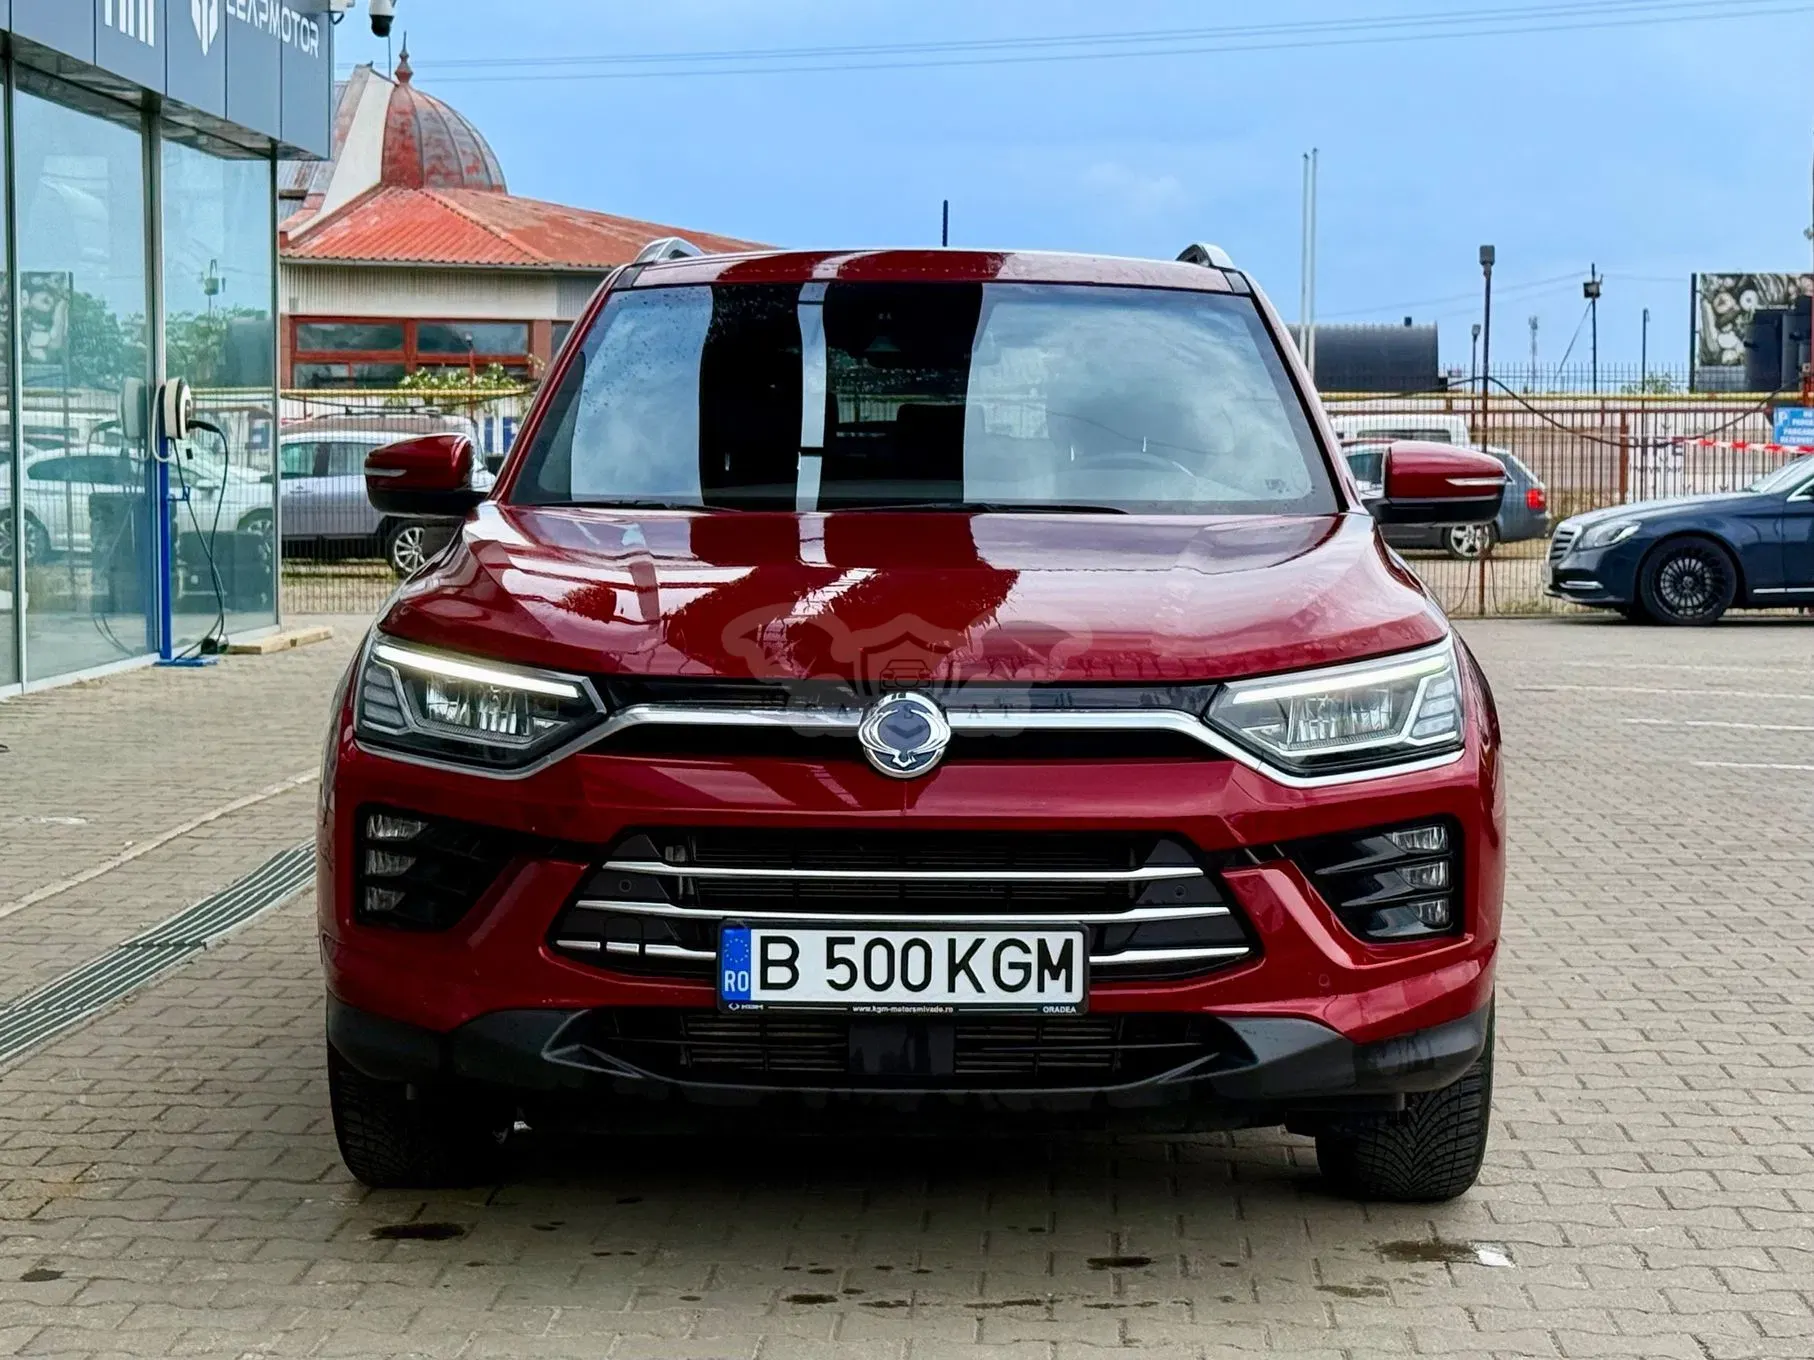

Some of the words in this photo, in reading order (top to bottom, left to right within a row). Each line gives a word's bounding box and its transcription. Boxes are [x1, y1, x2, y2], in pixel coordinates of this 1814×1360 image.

[759, 935, 800, 991] B
[826, 936, 932, 992] 500
[947, 937, 1073, 993] KGM
[724, 970, 749, 992] RO
[1042, 1005, 1077, 1014] ORADEA
